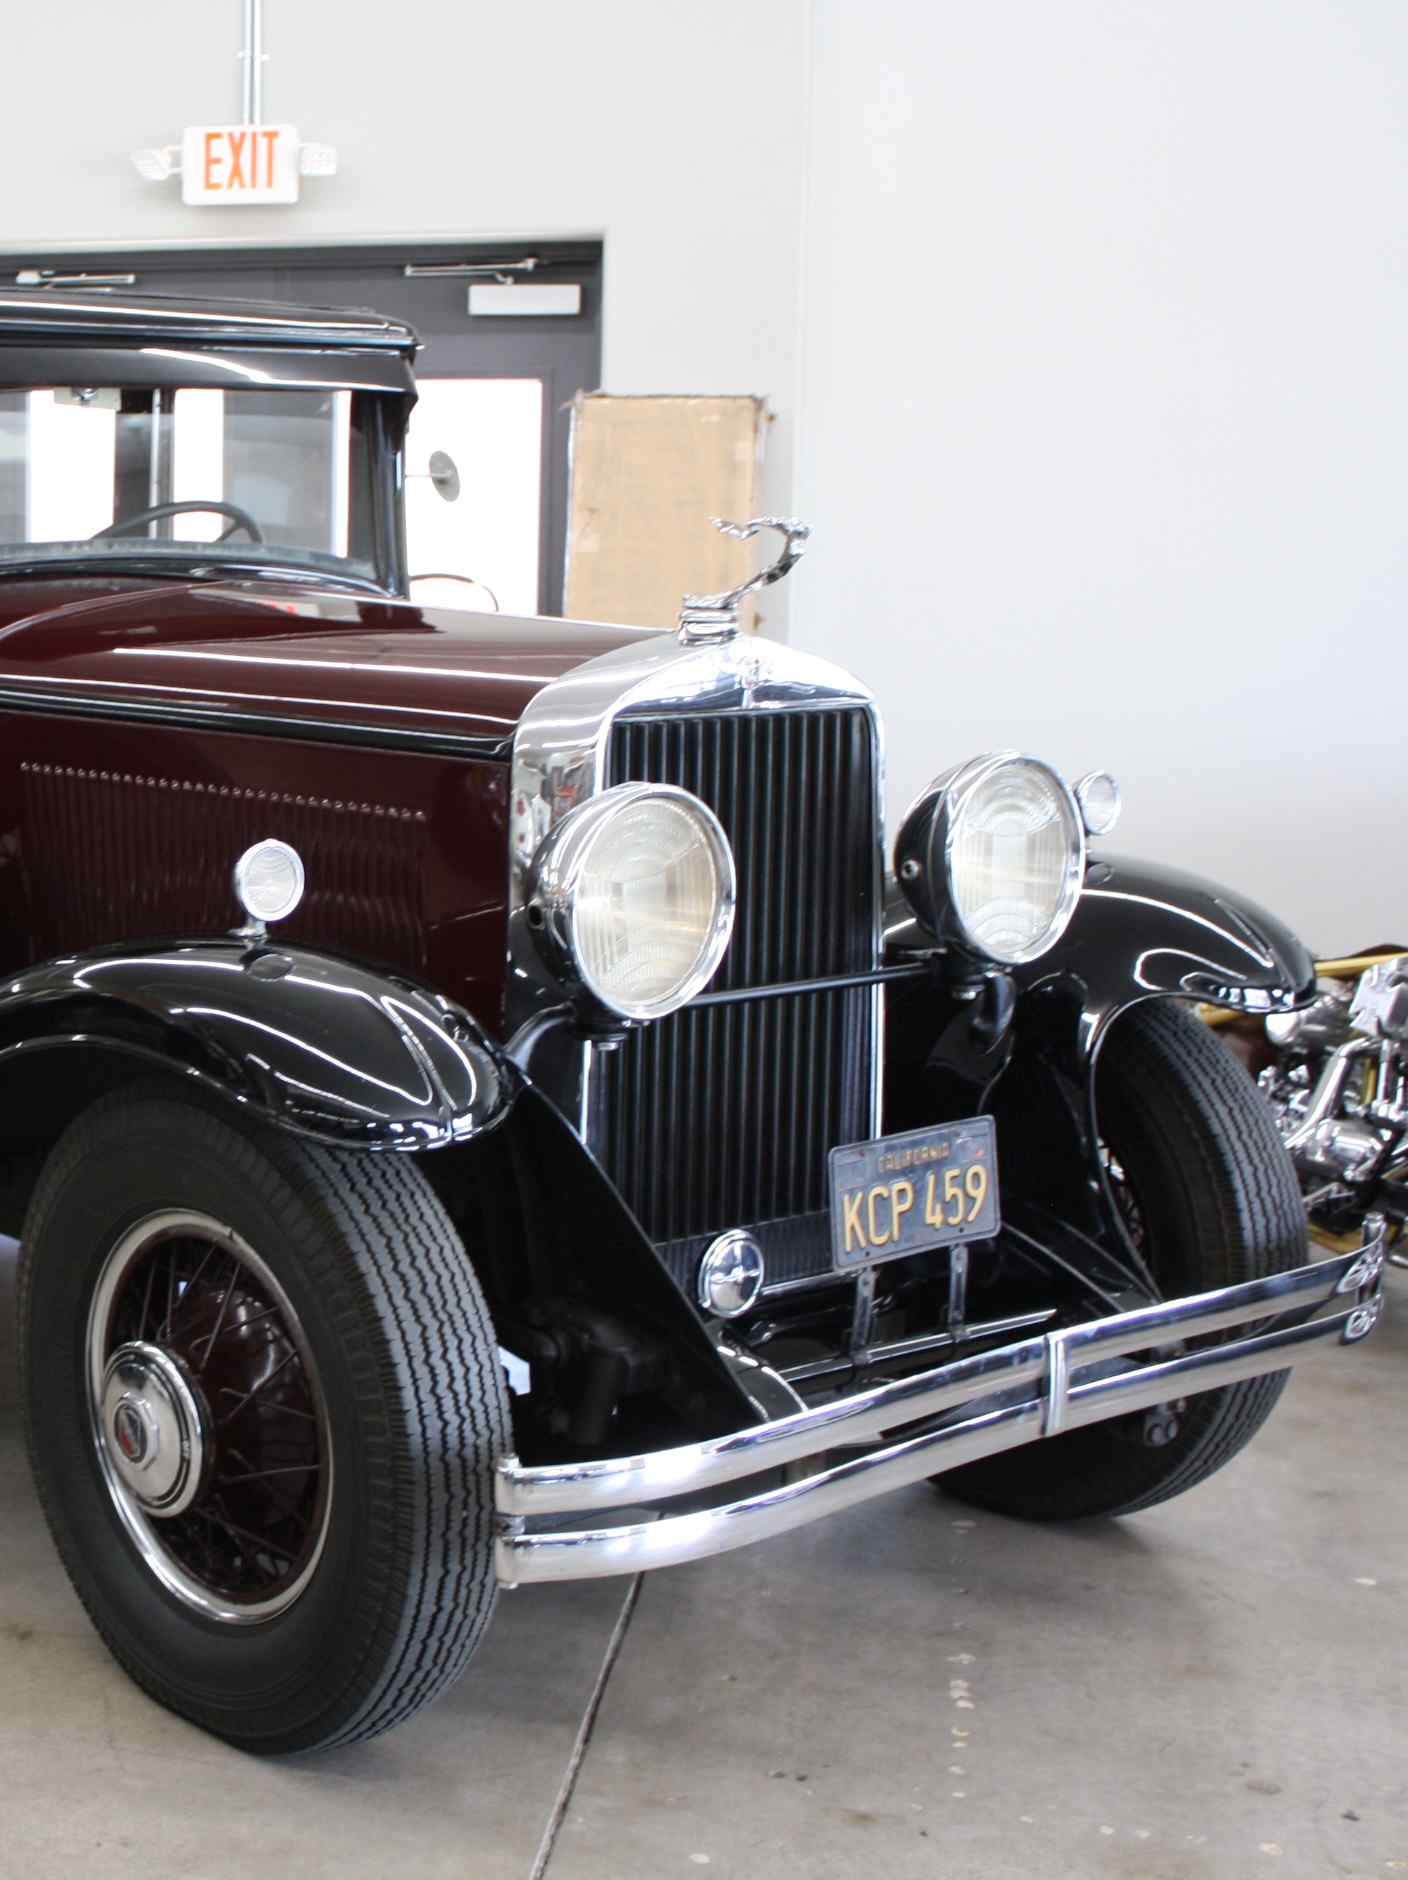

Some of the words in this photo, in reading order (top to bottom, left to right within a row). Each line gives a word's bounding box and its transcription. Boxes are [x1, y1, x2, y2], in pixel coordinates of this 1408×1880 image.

[203, 131, 280, 190] EXIT
[843, 1180, 914, 1252] KCP
[925, 1164, 988, 1229] 459
